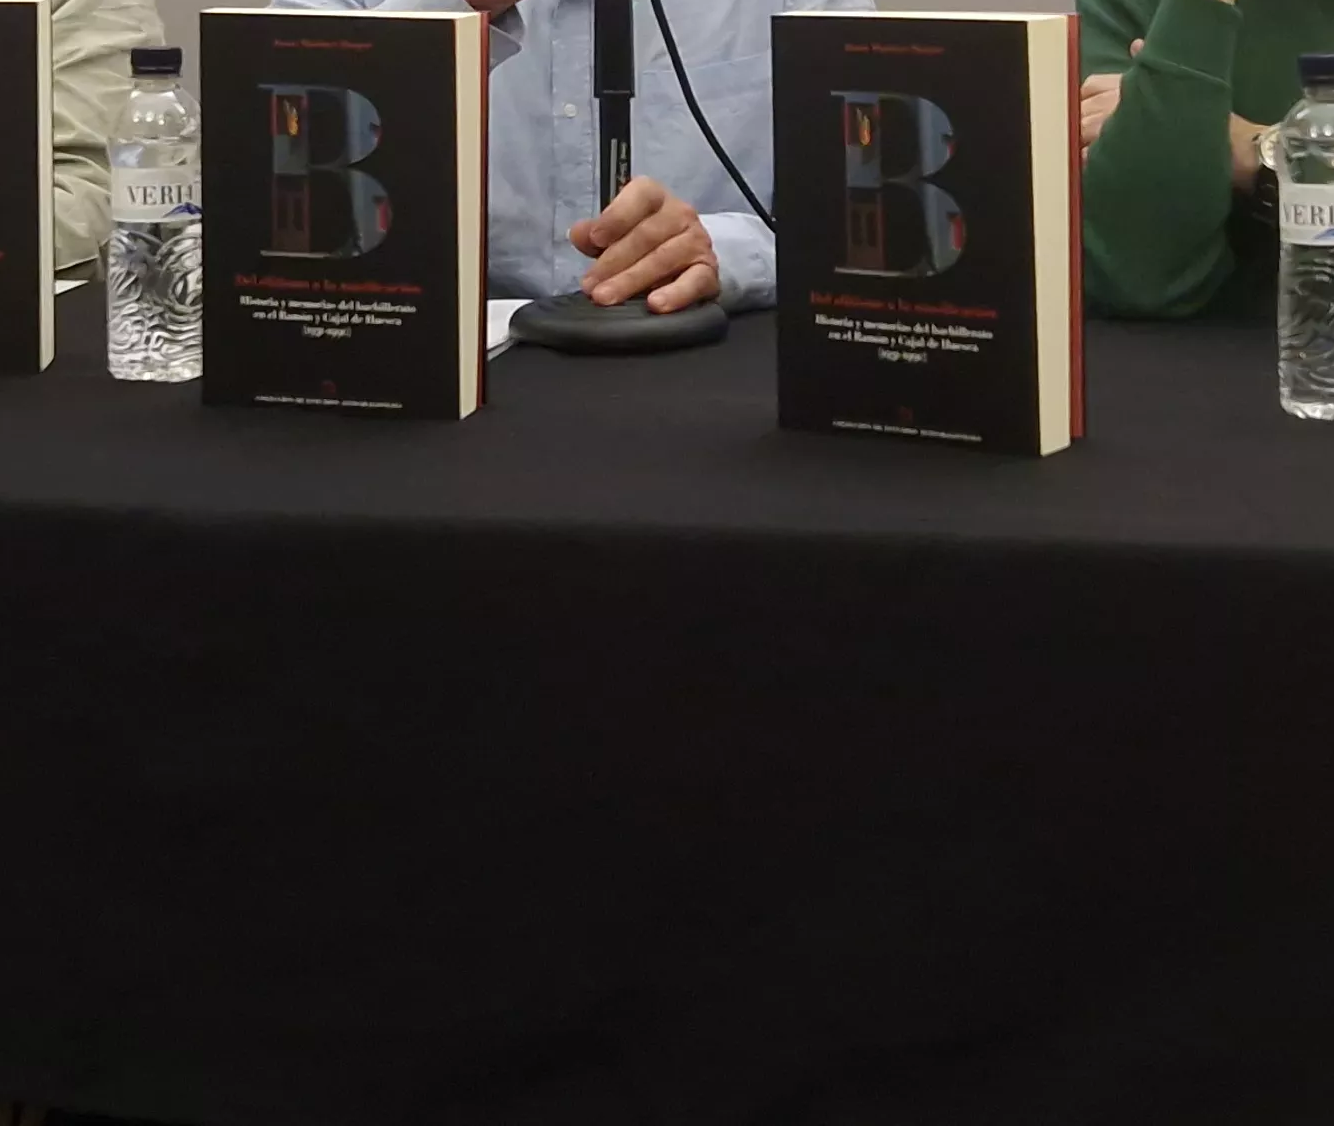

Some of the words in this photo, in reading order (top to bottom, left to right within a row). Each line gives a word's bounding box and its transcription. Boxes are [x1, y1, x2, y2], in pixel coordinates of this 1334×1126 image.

[337, 299, 355, 311] del
[267, 309, 277, 319] el
[913, 322, 930, 334] del
[842, 330, 852, 341] el
